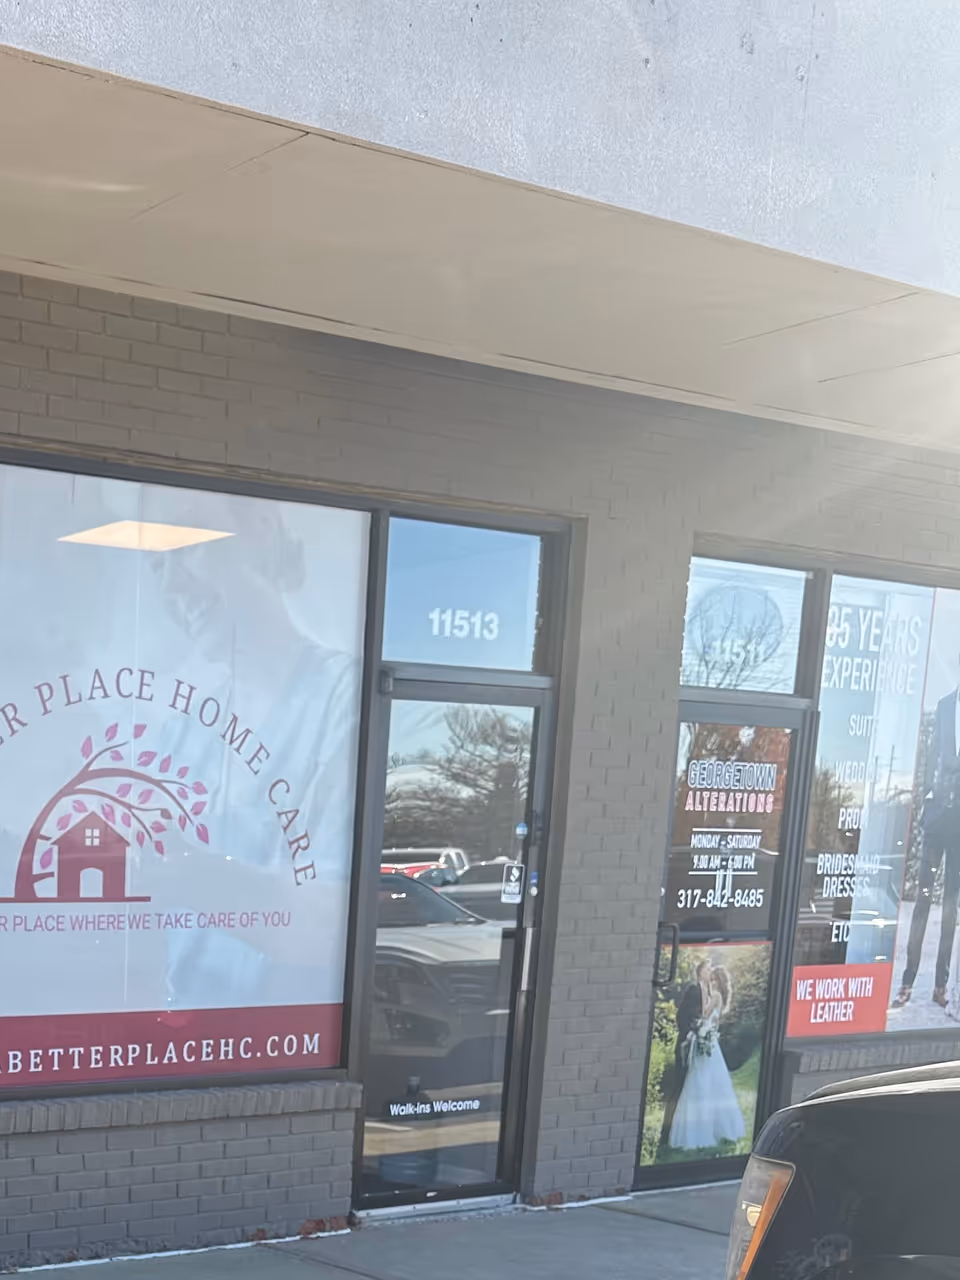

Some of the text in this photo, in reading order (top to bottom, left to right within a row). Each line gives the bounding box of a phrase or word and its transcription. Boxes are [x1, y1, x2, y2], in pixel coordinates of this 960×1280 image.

[429, 608, 499, 641] 11513
[859, 607, 922, 656] YEARS
[821, 655, 917, 695] EXPERIENCE
[34, 667, 155, 718] PLACE
[168, 678, 271, 777] HOME
[267, 778, 317, 887] CARE
[688, 760, 777, 790] GEORGETOWN
[685, 791, 774, 813] ALTERATIONS
[690, 834, 720, 848] MONDAY
[727, 834, 762, 849] SATURDAY
[817, 853, 880, 875] BRIDESMAID
[823, 876, 870, 898] DRESSES
[13, 914, 66, 933] PLACE
[156, 912, 193, 931] TAKE
[196, 912, 237, 930] CARE
[239, 912, 260, 929] OF
[262, 911, 291, 929] YOU
[797, 976, 873, 1000] WE WORK WITH
[810, 1001, 854, 1023] LEATHER
[390, 1099, 480, 1116] Walk-ins Welcome
